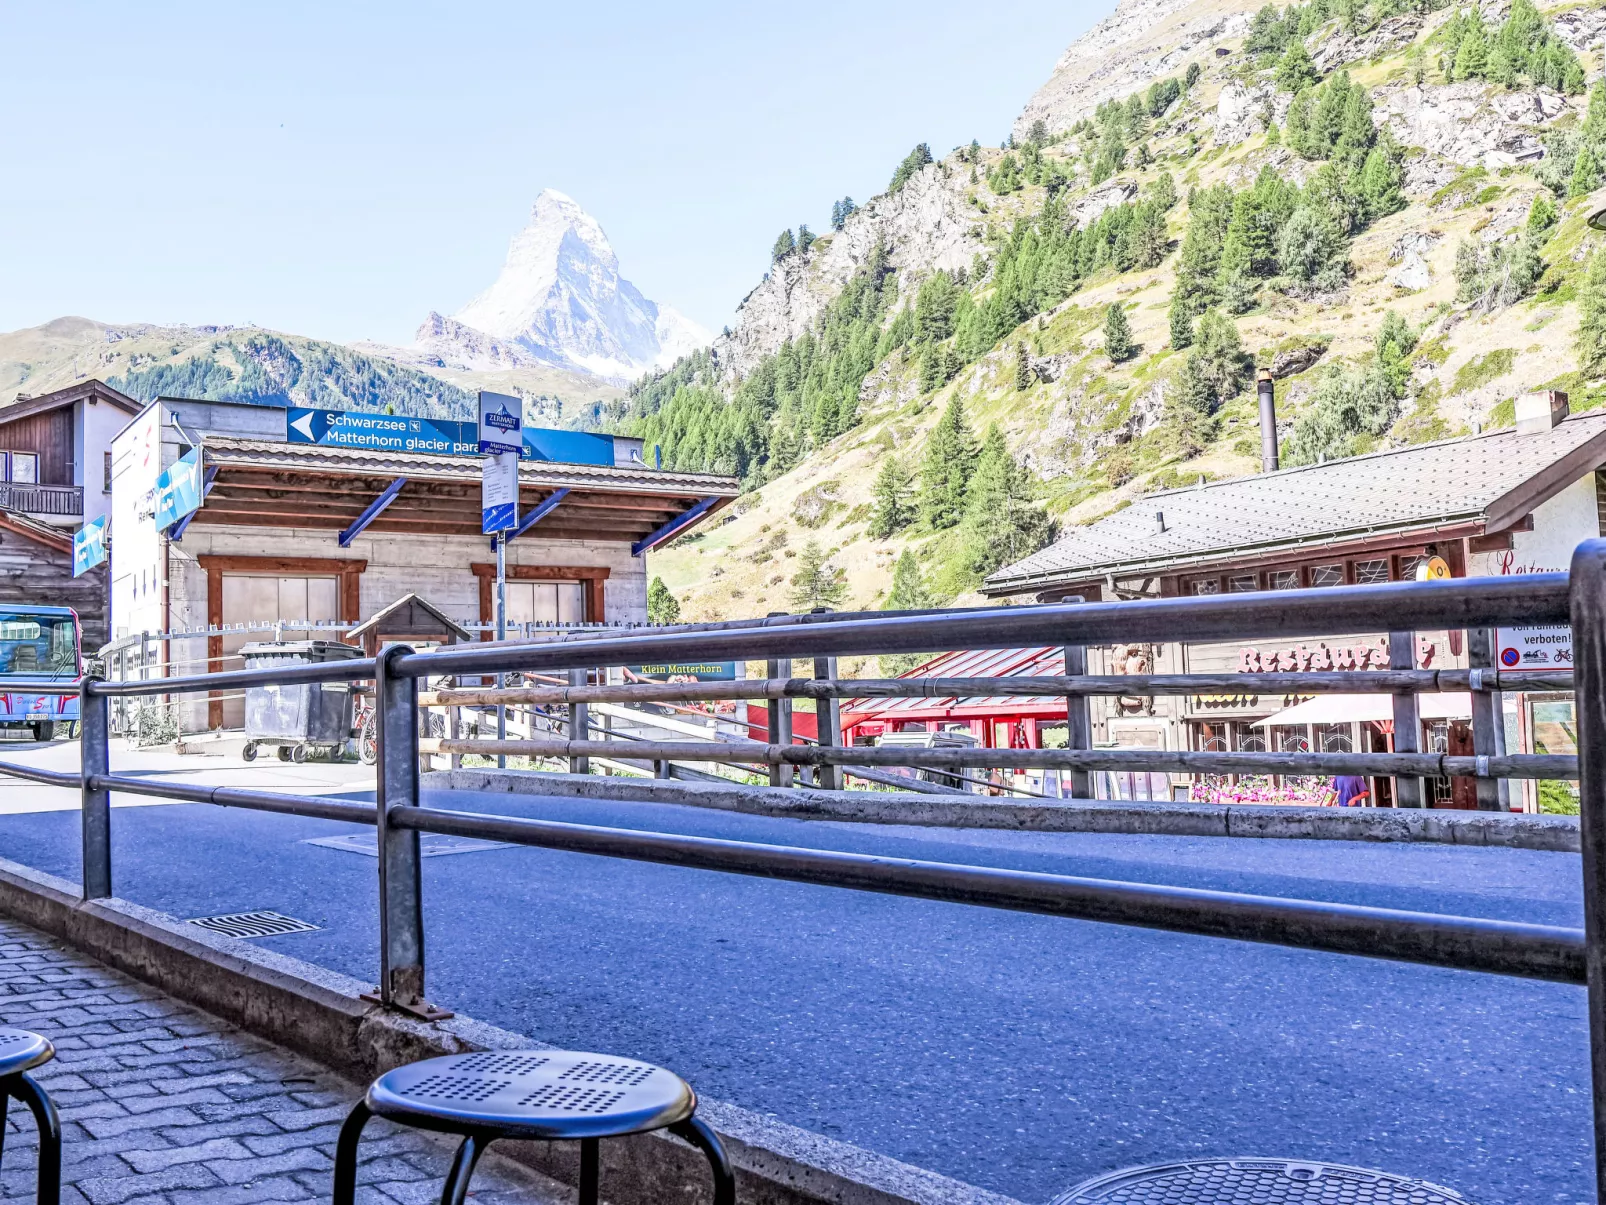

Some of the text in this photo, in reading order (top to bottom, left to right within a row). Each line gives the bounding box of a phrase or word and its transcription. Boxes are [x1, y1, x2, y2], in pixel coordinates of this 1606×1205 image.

[326, 413, 407, 431] Schwarzsee
[489, 414, 517, 426] ZERMATT
[327, 430, 479, 455] Matterhorn glacier para
[490, 442, 517, 452] Matterhorn
[1524, 634, 1572, 645] verboten!
[1236, 636, 1434, 673] Restaurat
[641, 664, 722, 674] Klein Matterhorn
